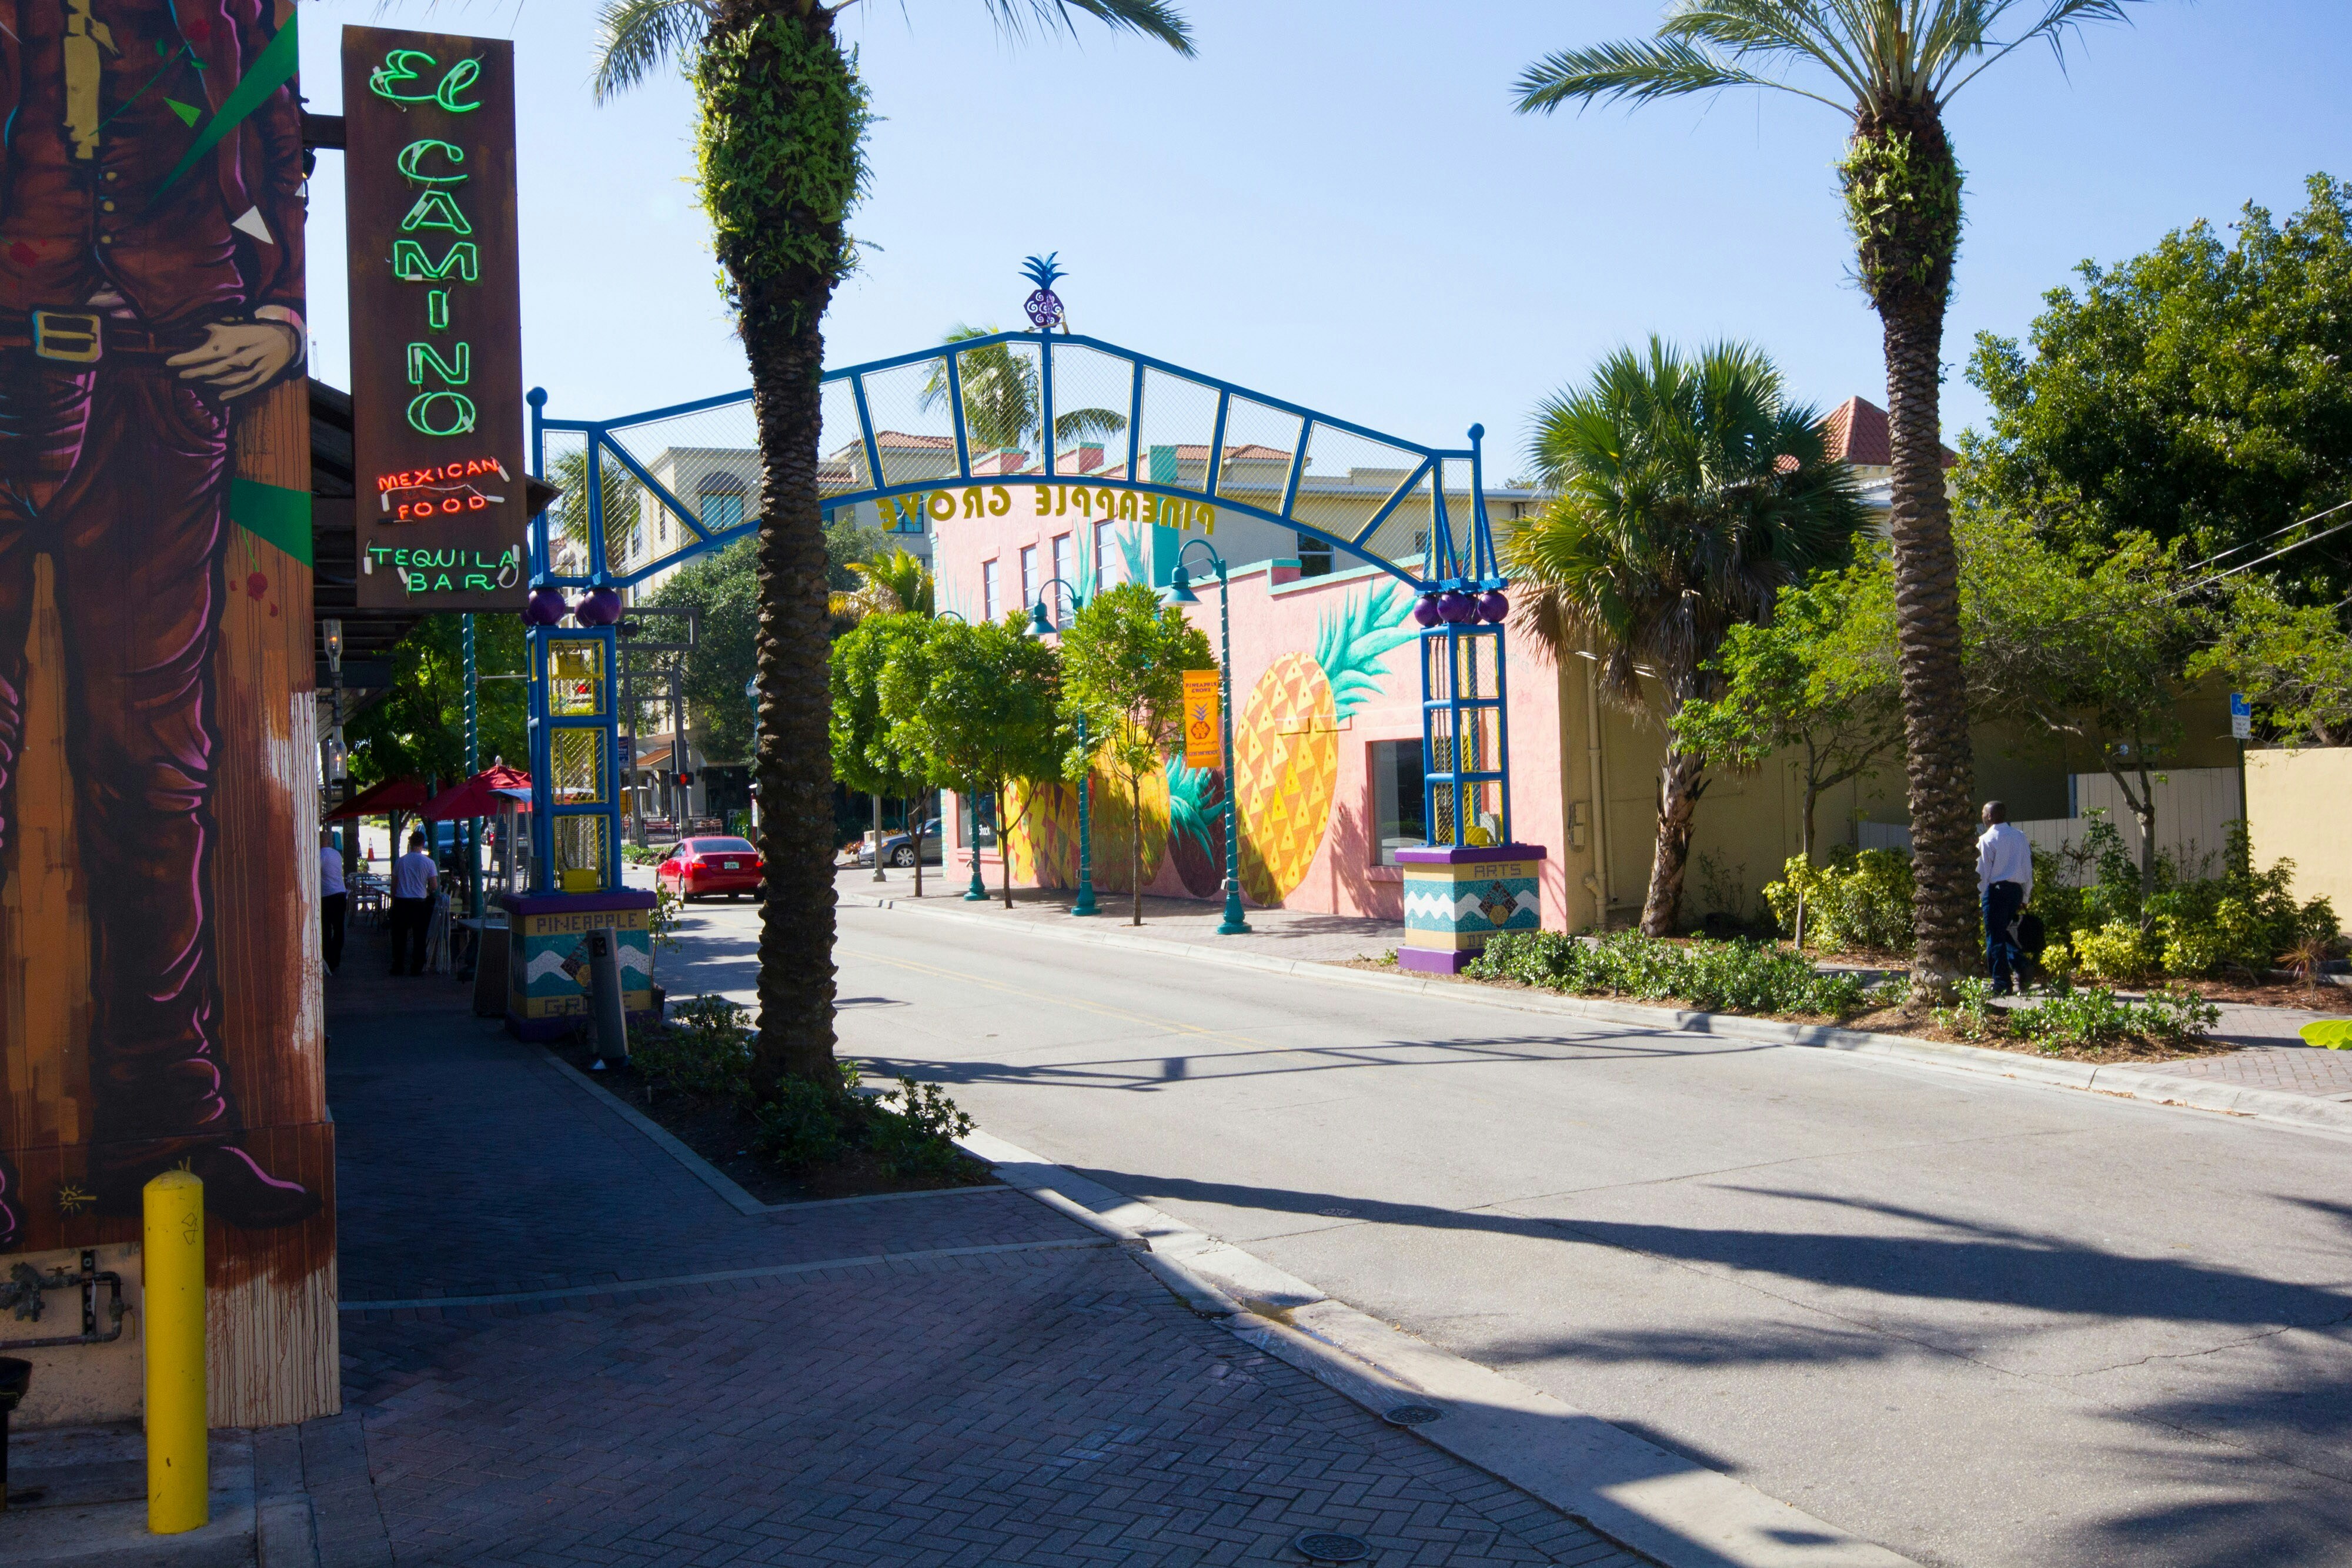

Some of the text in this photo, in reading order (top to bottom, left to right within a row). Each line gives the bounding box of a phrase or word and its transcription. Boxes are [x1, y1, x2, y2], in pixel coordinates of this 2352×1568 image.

[370, 49, 480, 112] El
[393, 139, 478, 436] CAMINO
[377, 458, 500, 492] MEXICAN
[398, 496, 486, 520] FOOD
[369, 547, 517, 569] TEQUILA
[407, 573, 496, 592] BAR
[1474, 863, 1521, 878] ARTS
[536, 912, 637, 932] PINEAPPLE
